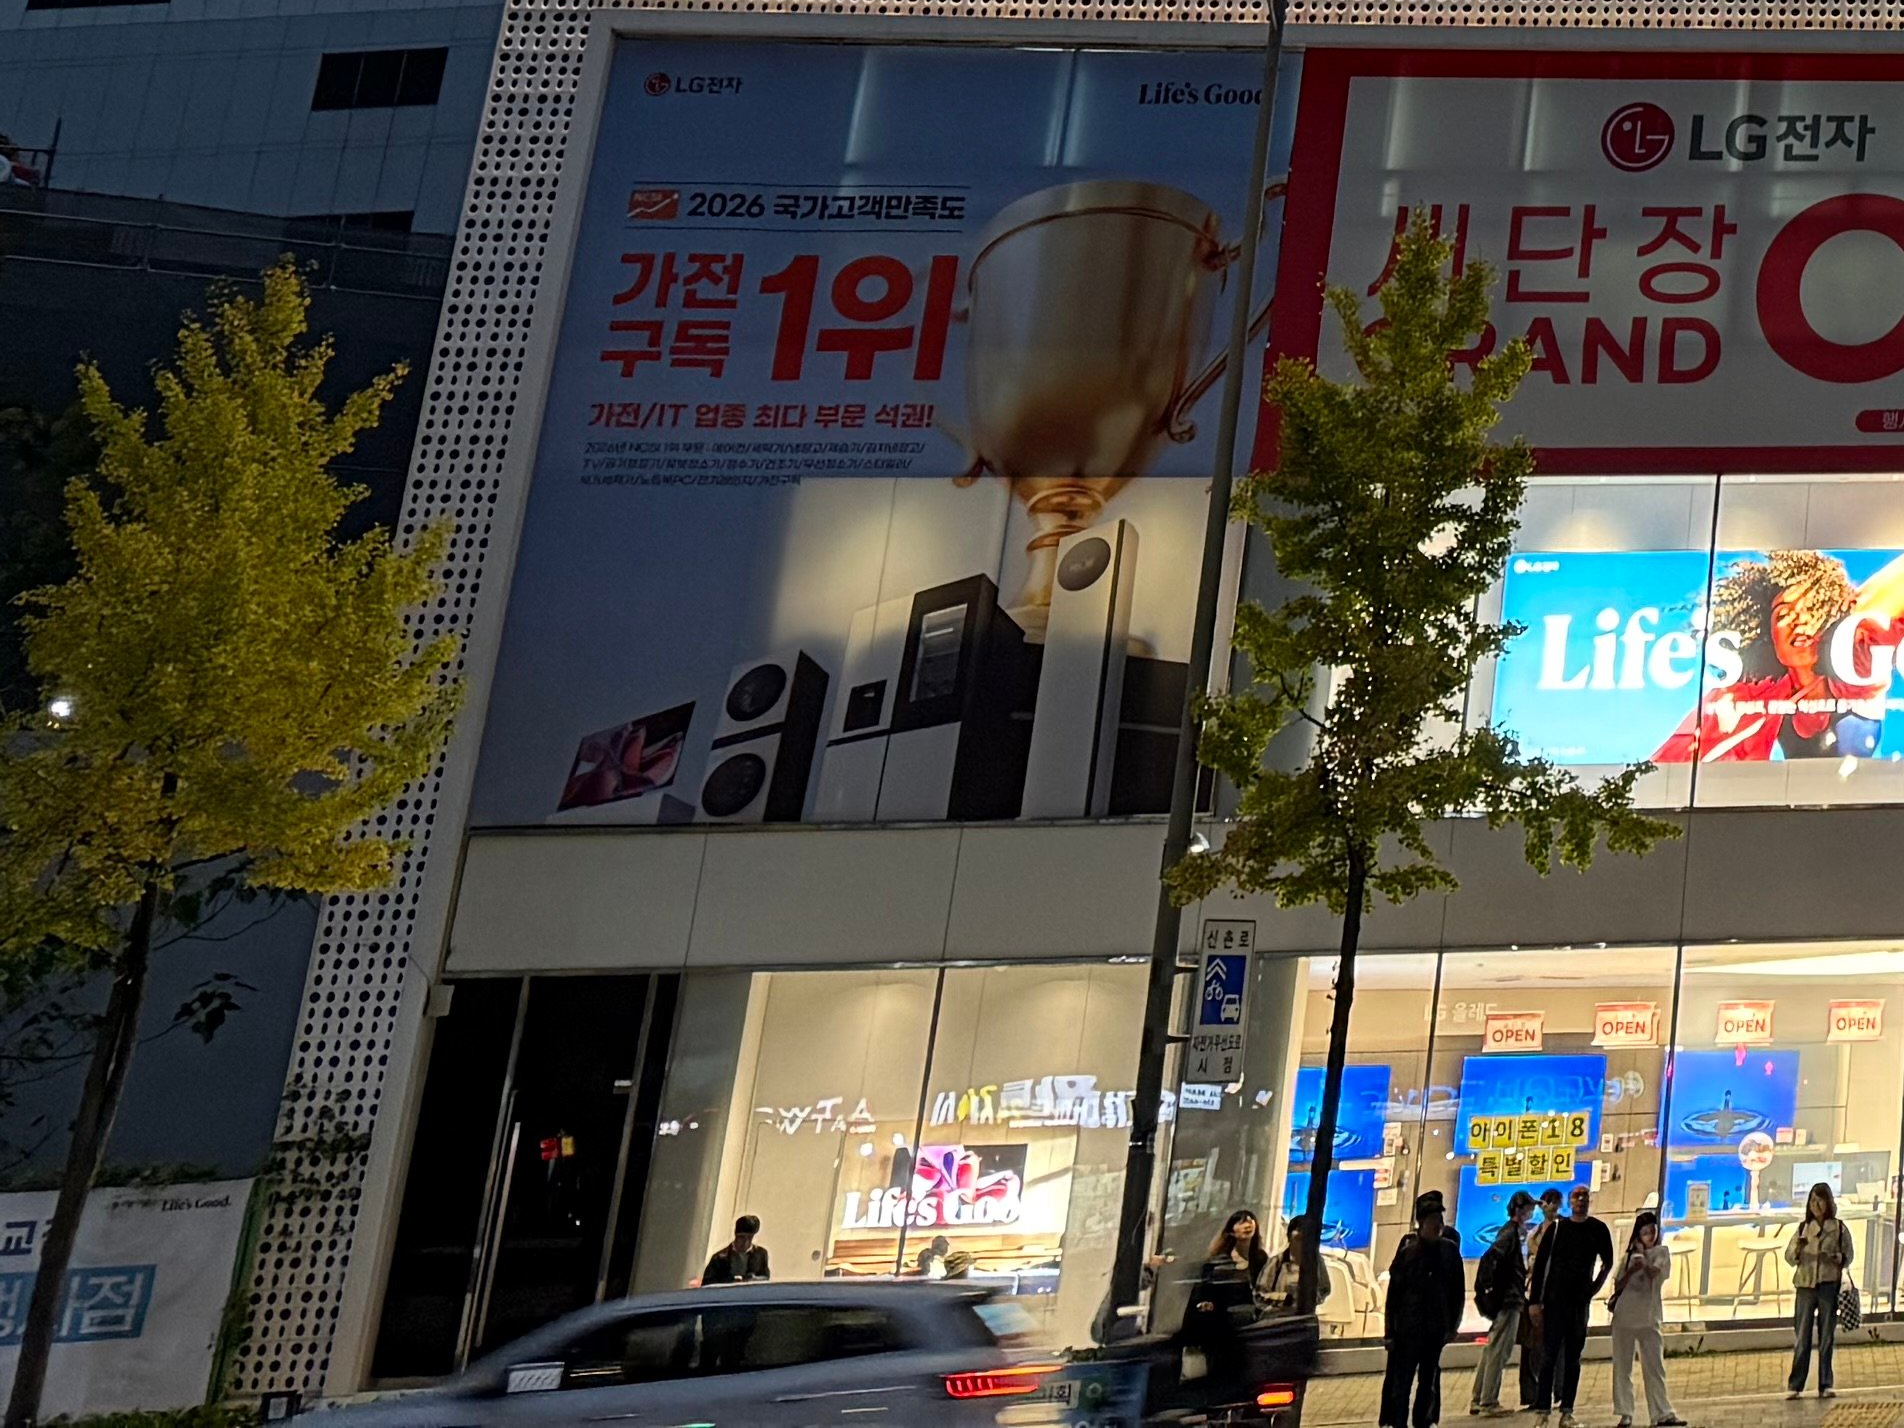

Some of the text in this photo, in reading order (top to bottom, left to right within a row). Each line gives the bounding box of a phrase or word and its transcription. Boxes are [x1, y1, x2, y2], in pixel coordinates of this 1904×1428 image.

[674, 76, 744, 95] LG전자
[1138, 81, 1199, 105] Life's
[1688, 113, 1877, 163] LG전자
[686, 193, 768, 219] 2026
[772, 194, 967, 221] 국가고객만족도
[610, 250, 960, 382] 가전 1위
[600, 317, 732, 379] 구독
[1362, 315, 1722, 385] RAND
[587, 402, 936, 431] 가전/IT 업종 최다 부문 석권!
[1537, 605, 1745, 692] Life's
[1207, 929, 1250, 949] 신촌로
[1491, 1027, 1537, 1044] OPEN
[1601, 1020, 1647, 1036] OPEN
[1723, 1019, 1766, 1035] OPEN
[1835, 1017, 1877, 1031] OPEN
[1478, 1151, 1572, 1178] 특별할인
